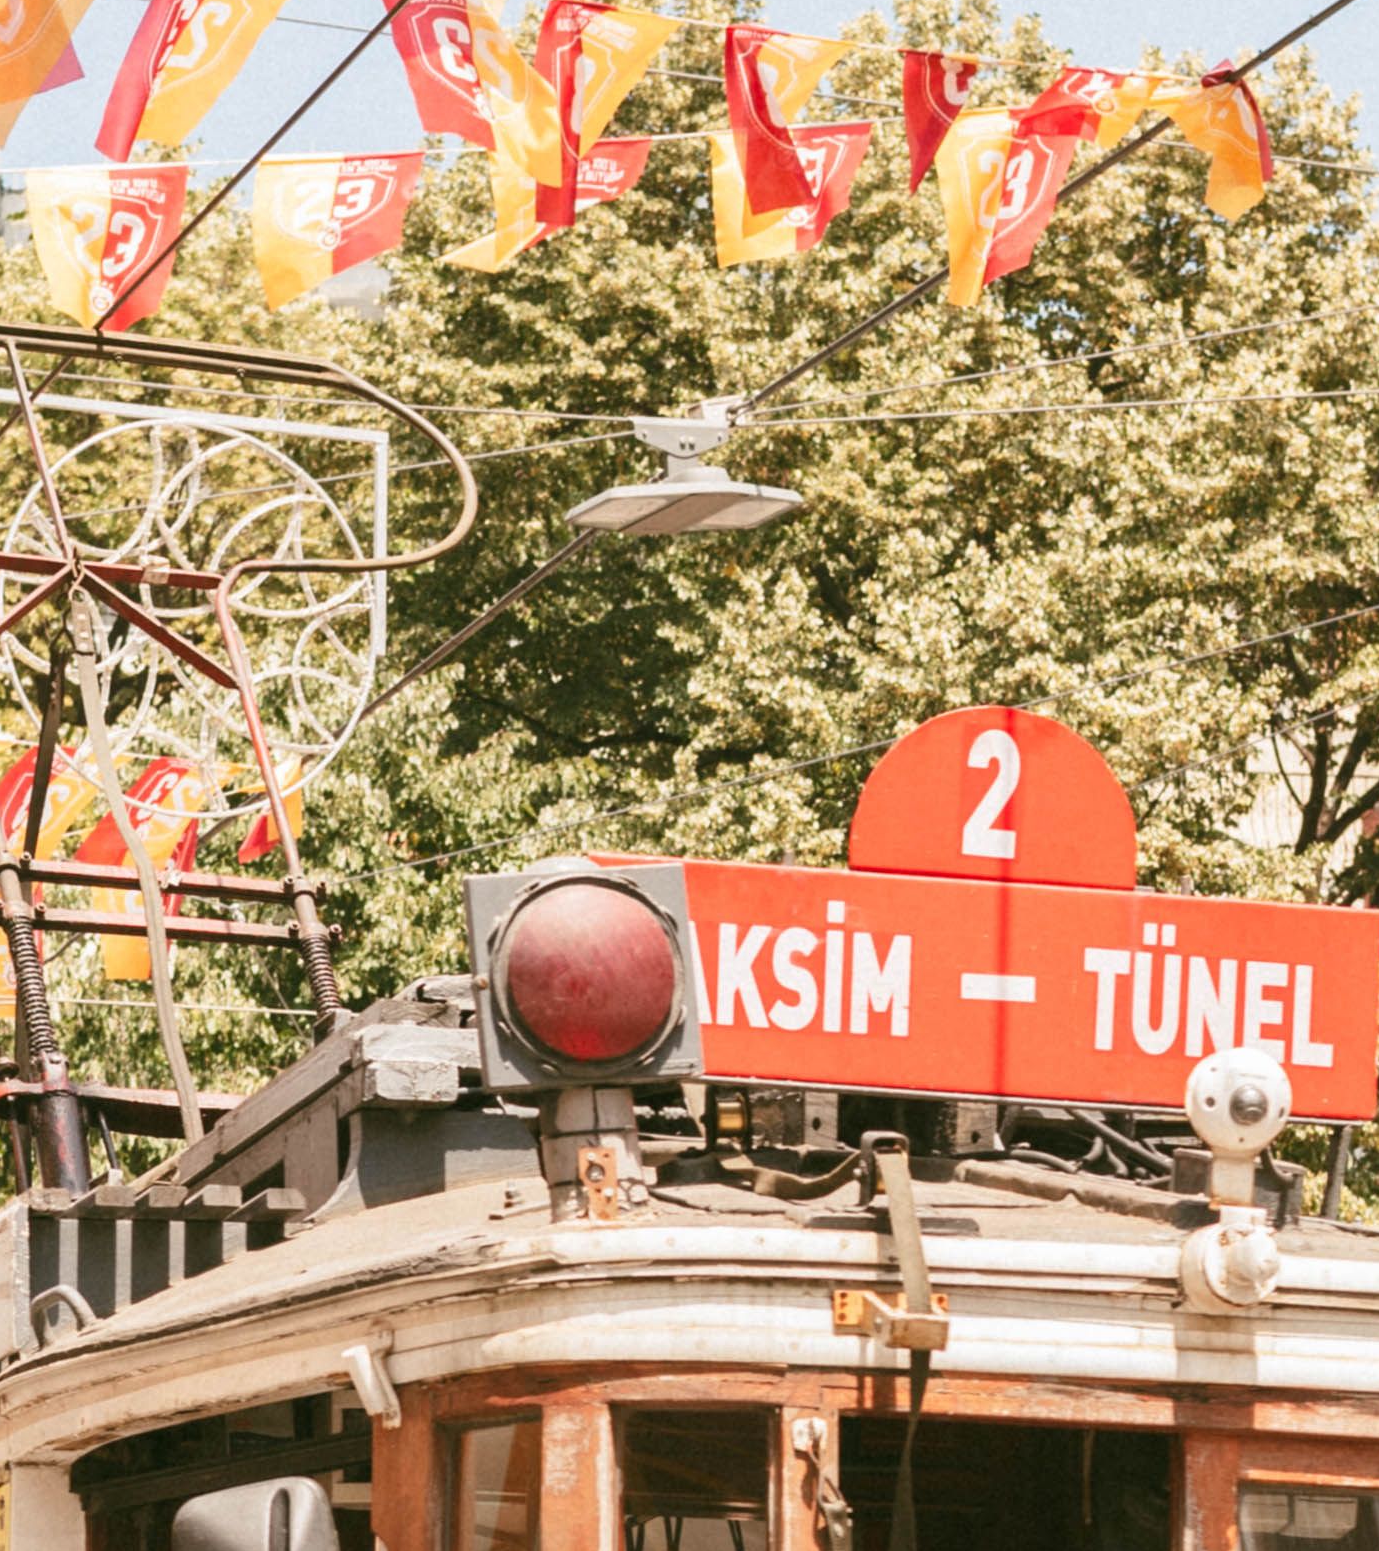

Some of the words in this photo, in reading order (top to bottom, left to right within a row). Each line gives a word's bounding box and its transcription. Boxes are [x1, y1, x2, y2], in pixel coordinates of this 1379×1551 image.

[294, 179, 376, 232] 23
[977, 148, 1034, 229] 23
[71, 201, 146, 279] 23
[962, 729, 1021, 859] 2
[1084, 923, 1334, 1068] TÜNEL
